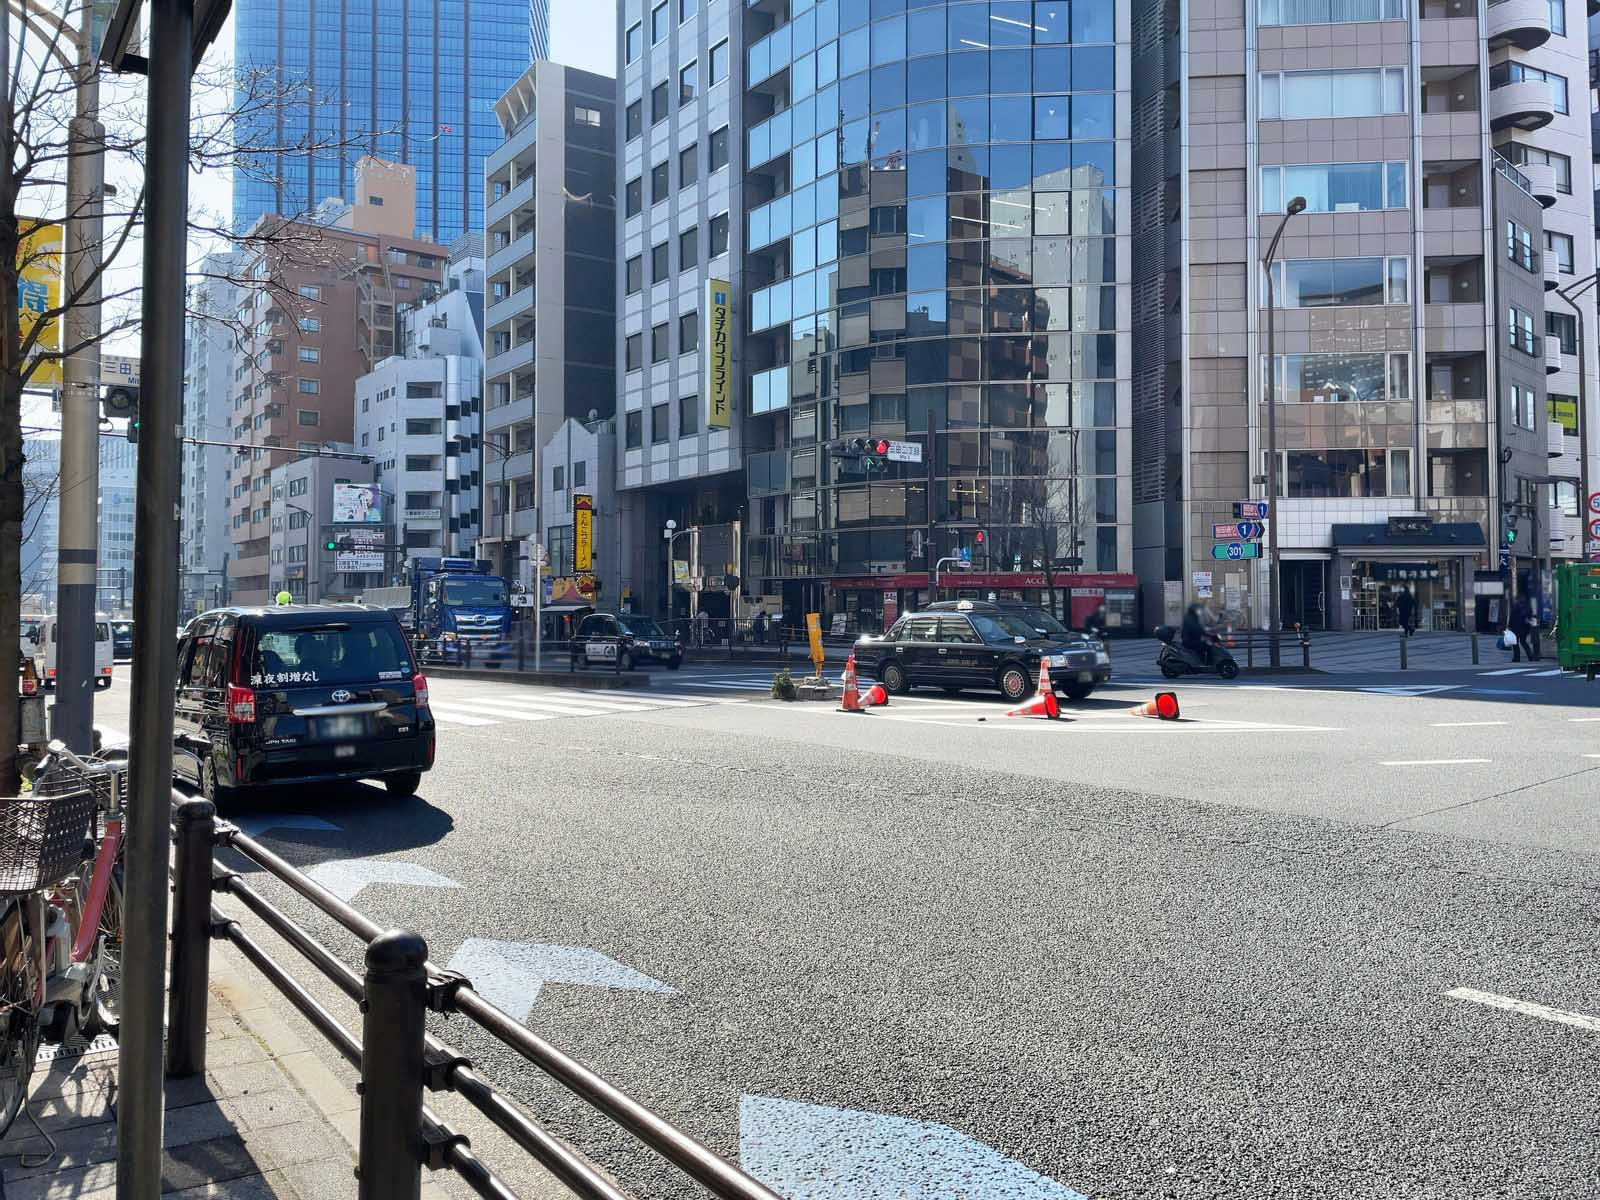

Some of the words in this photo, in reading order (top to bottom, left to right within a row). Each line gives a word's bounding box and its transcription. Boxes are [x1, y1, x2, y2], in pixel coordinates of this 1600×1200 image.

[715, 307, 726, 416] タチカワブラインド
[127, 376, 140, 385] Mit
[580, 511, 588, 569] とんこつラーメン
[1228, 546, 1242, 556] 301
